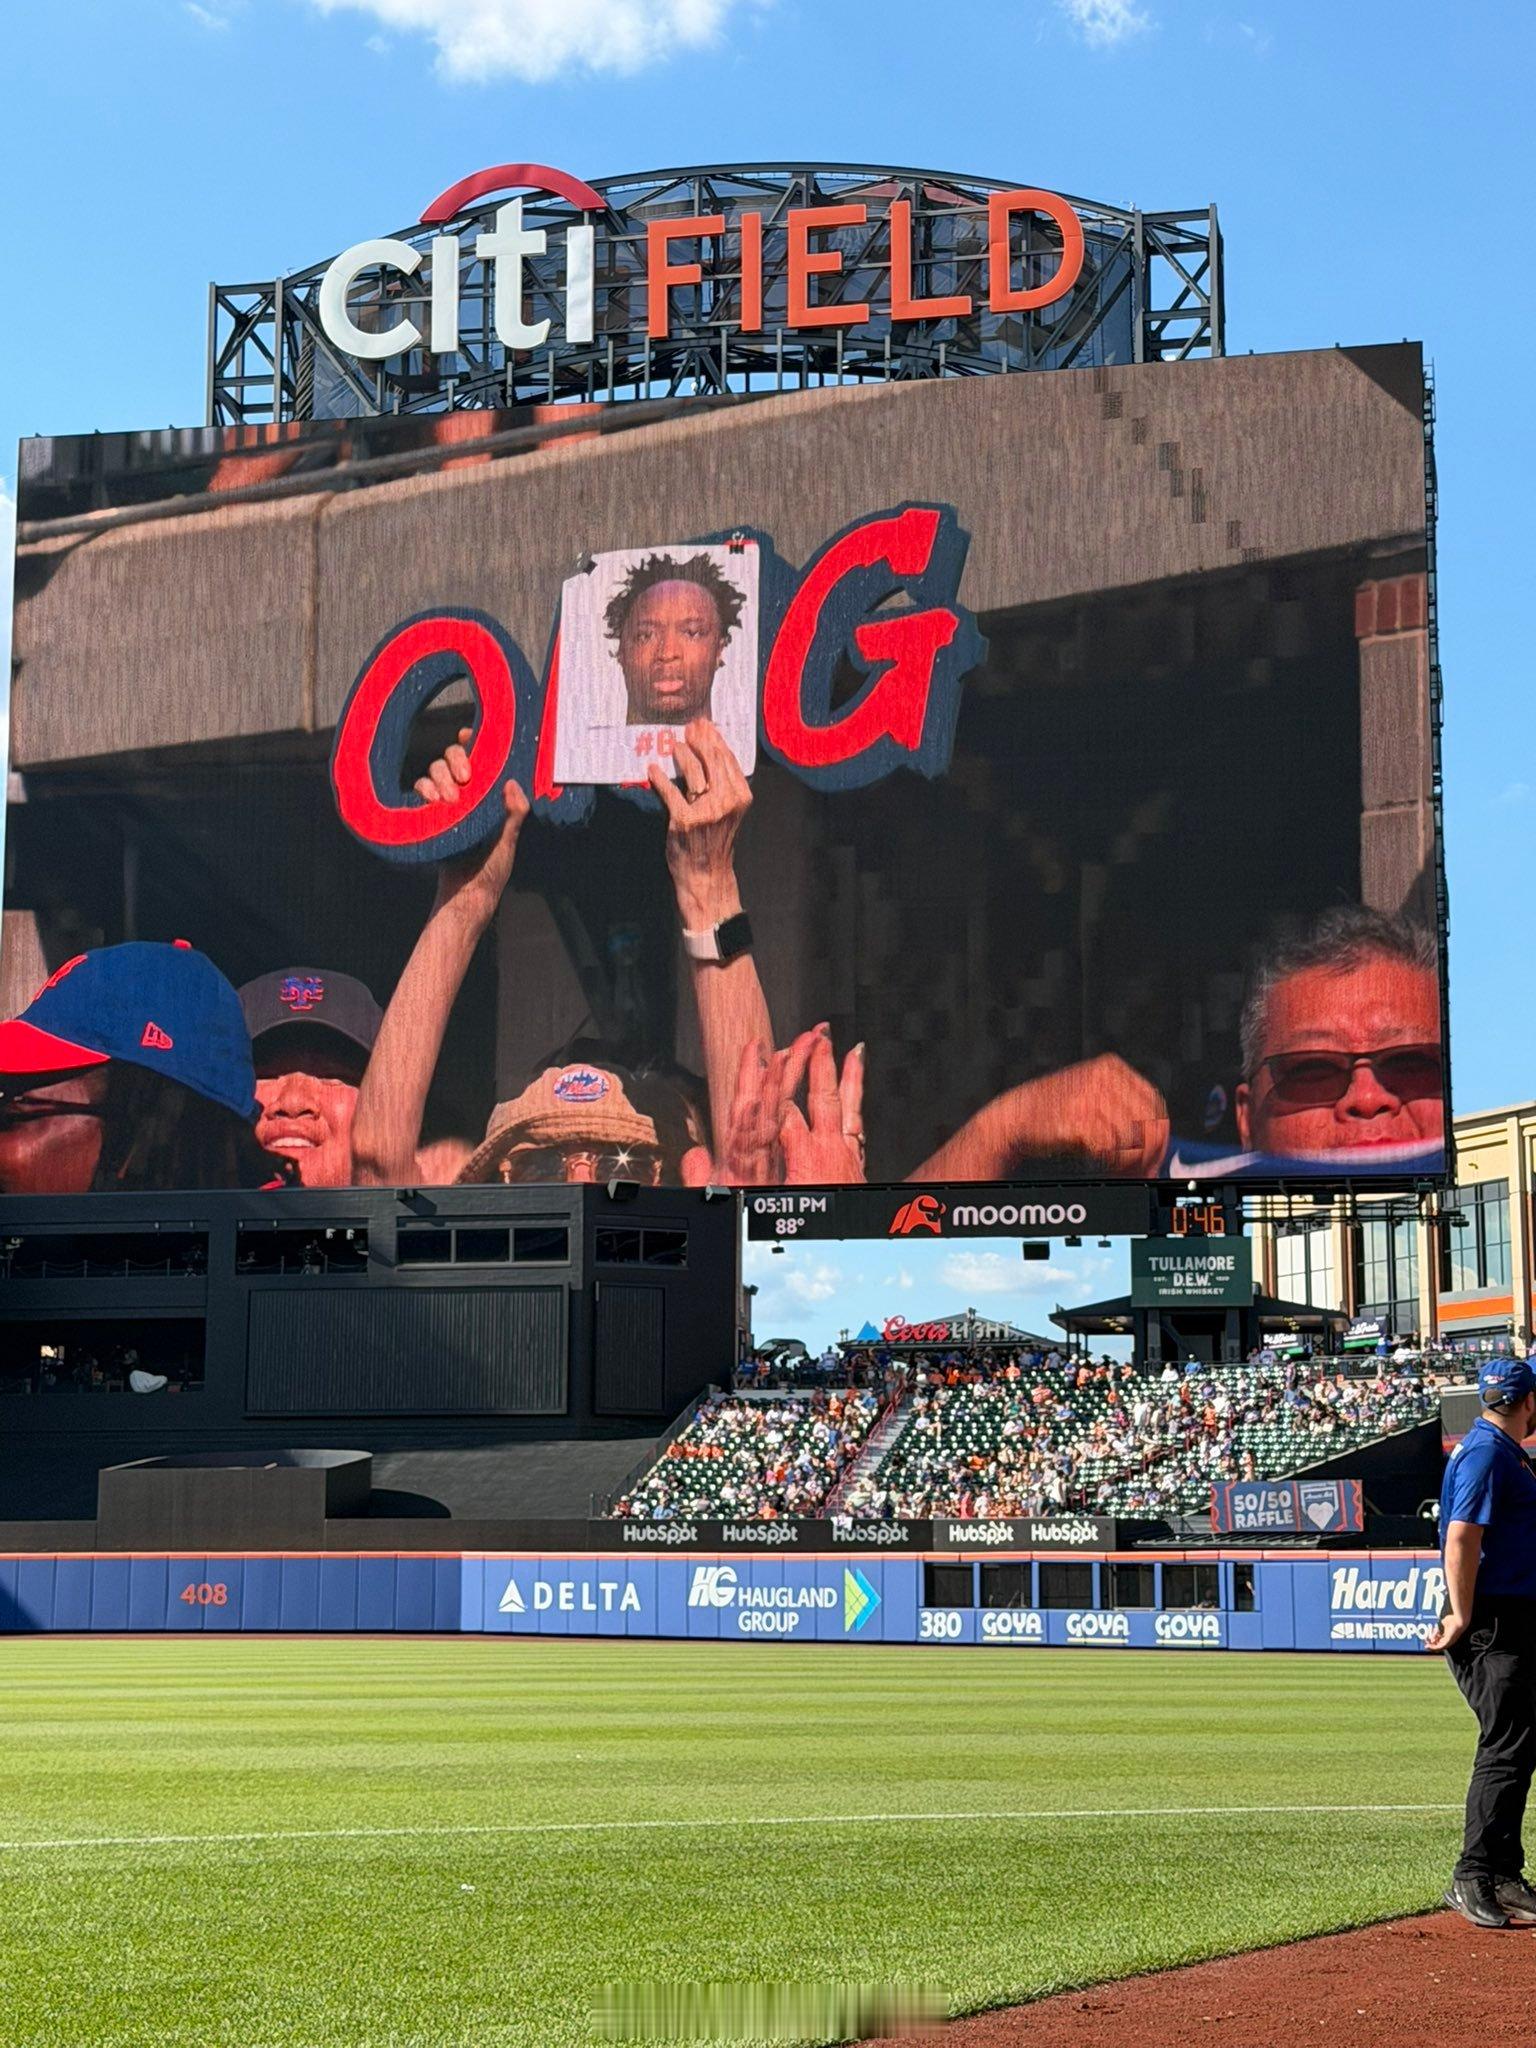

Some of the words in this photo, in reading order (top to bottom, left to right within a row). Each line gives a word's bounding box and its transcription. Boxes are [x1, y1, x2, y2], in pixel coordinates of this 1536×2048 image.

[319, 197, 595, 359] citi
[648, 189, 1086, 338] FIELD
[753, 1197, 793, 1213] 05:11
[799, 1197, 827, 1213] PM
[953, 1204, 1087, 1226] moomoo
[775, 1217, 805, 1235] 88°
[1148, 1256, 1235, 1271] TULLAMORE
[884, 1315, 949, 1342] Coors
[1234, 1490, 1291, 1511] 50/50
[1235, 1510, 1294, 1529] RAFFLE
[623, 1522, 698, 1544] HubSpot
[722, 1522, 798, 1544] HubSpot
[949, 1520, 1014, 1545] HubSpot
[1031, 1520, 1099, 1545] HubSpot
[180, 1583, 228, 1605] 408
[533, 1581, 642, 1612] DELTA
[738, 1587, 838, 1608] HAUGLAND
[1331, 1567, 1420, 1610] Hard
[738, 1611, 800, 1632] GROUP
[919, 1611, 963, 1638] 380
[982, 1611, 1043, 1635] GOYA
[1066, 1613, 1130, 1637] GOYA
[1155, 1614, 1221, 1638] GOYA
